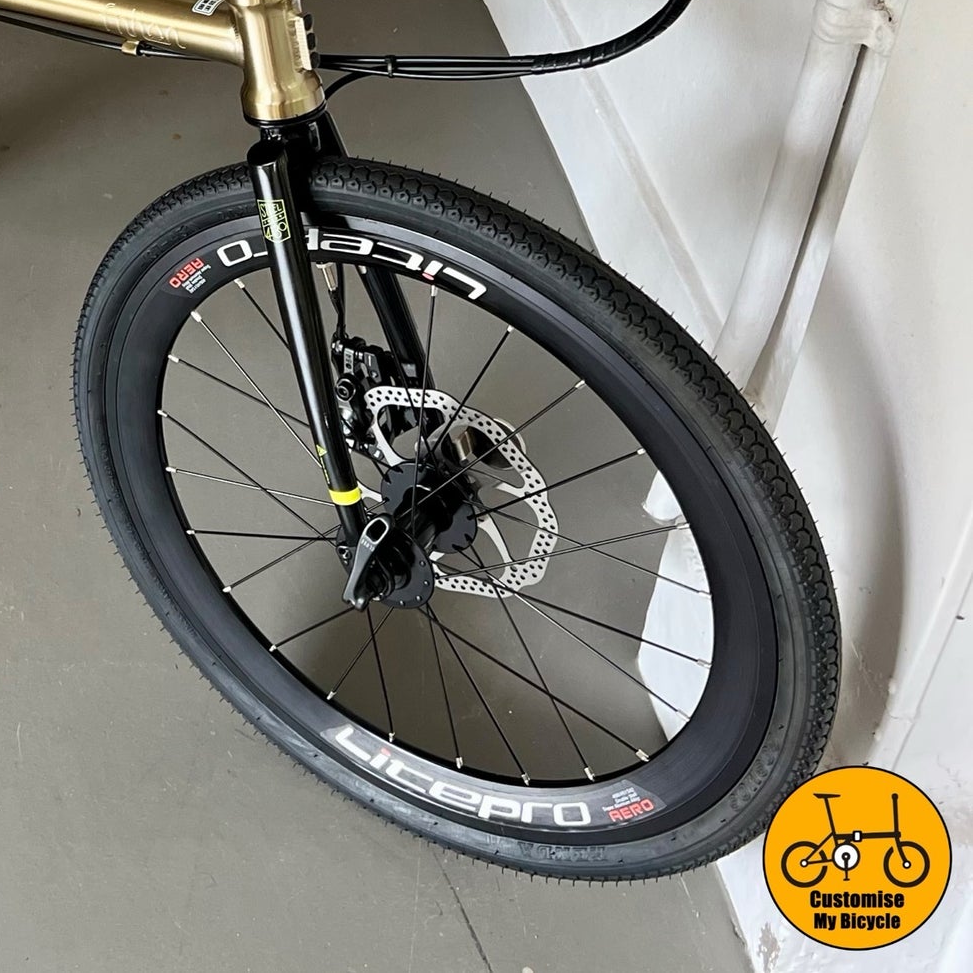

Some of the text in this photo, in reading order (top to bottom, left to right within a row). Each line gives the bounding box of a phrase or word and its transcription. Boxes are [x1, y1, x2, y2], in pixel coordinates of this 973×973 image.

[168, 257, 204, 289] AERO
[335, 726, 591, 827] Litepro
[608, 797, 655, 823] AERO
